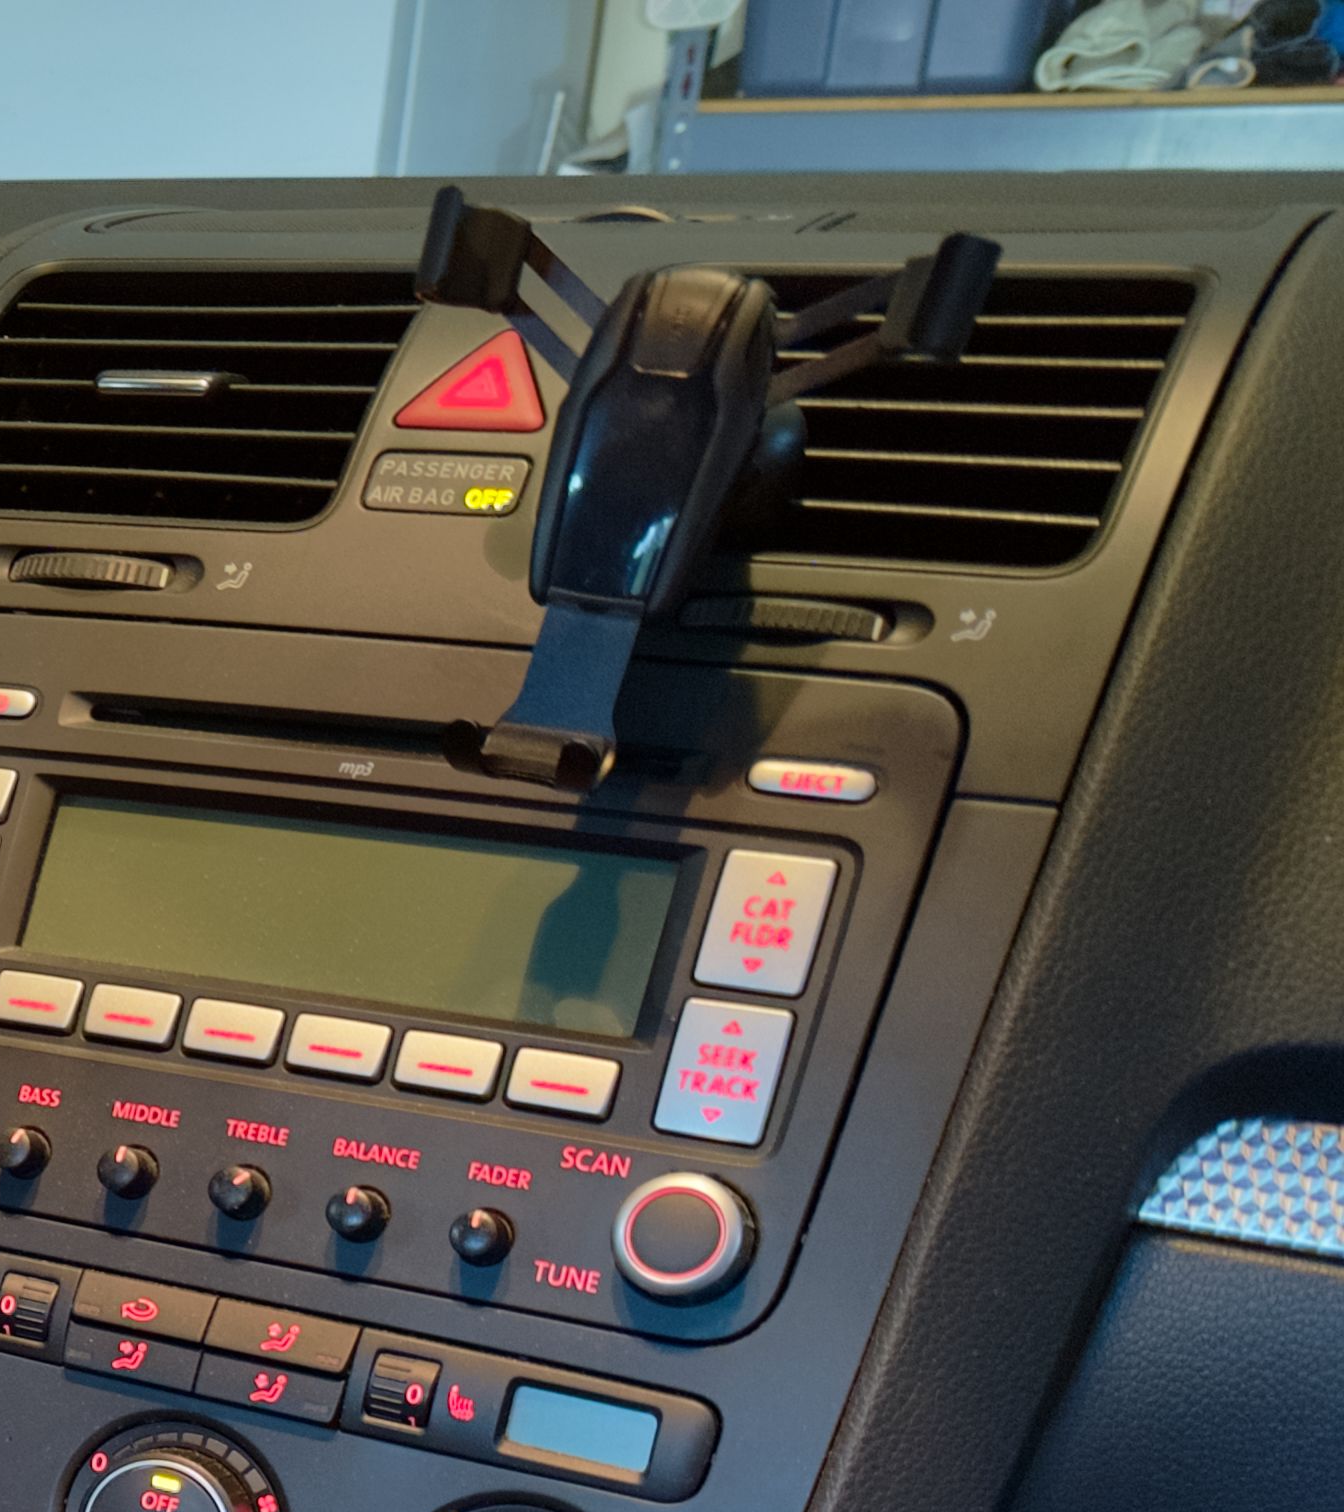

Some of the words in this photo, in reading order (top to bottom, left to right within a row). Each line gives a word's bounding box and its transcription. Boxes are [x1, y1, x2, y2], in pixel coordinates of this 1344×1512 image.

[378, 459, 515, 482] PASSENGER
[367, 485, 403, 504] AIR
[408, 487, 455, 506] BAG
[464, 487, 514, 511] OFF
[339, 759, 375, 779] mp3
[779, 771, 848, 794] EJECT
[742, 895, 796, 921] CAT
[730, 921, 794, 950] FLDR
[695, 1043, 758, 1073] SEEK
[18, 1085, 60, 1107] BASS
[678, 1068, 760, 1102] TRACK
[112, 1102, 179, 1127] MIDDLE
[228, 1119, 288, 1145] TREBLE
[333, 1137, 420, 1168] BALANCE
[560, 1145, 631, 1177] SCAN
[469, 1161, 532, 1188] FADER
[535, 1258, 600, 1294] TUNE
